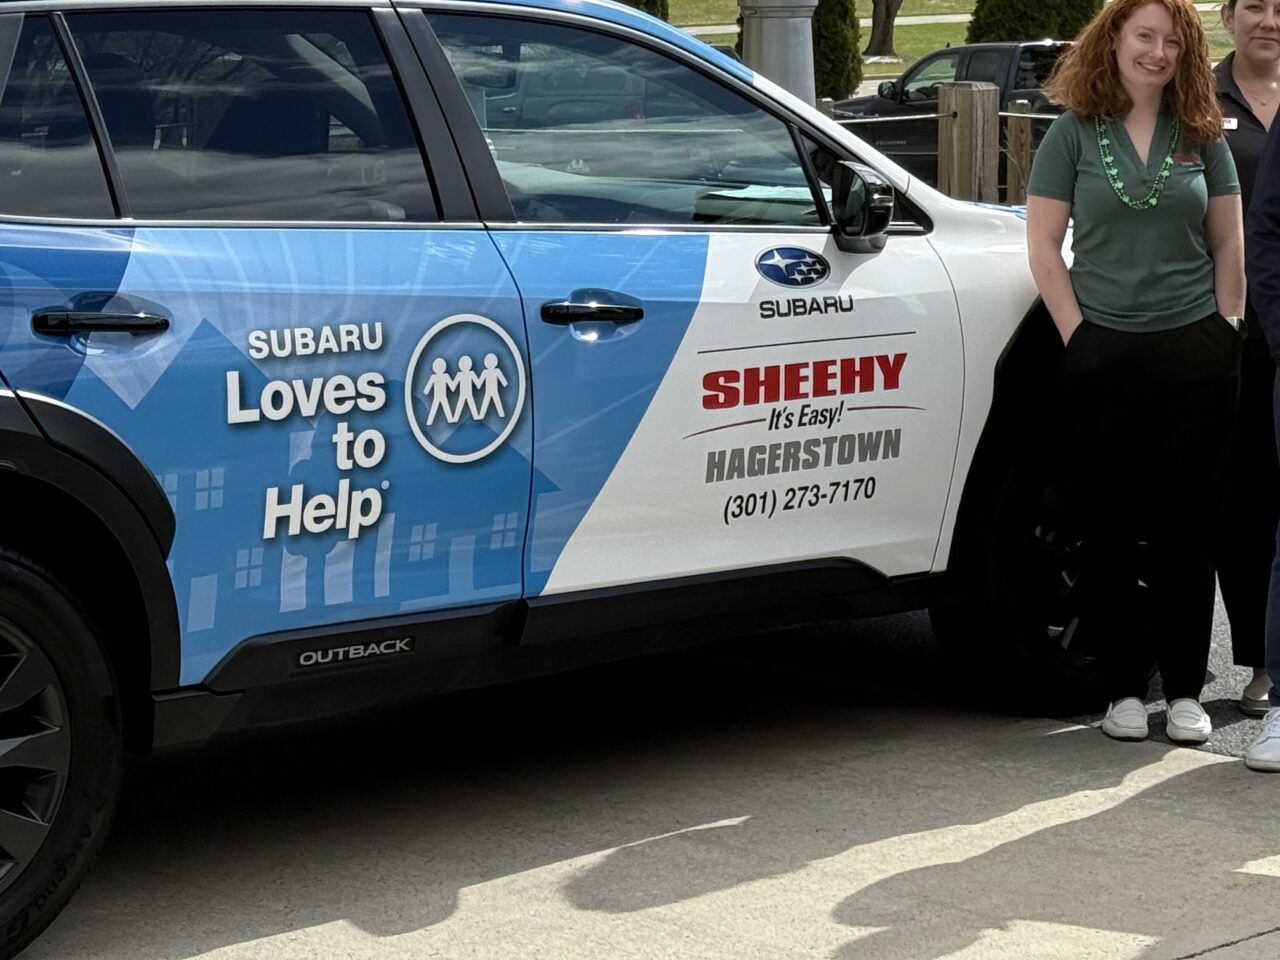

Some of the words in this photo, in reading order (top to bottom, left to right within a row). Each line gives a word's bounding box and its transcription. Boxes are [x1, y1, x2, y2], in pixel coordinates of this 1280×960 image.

[759, 295, 854, 319] SUBARU
[249, 322, 383, 359] SUBARU
[226, 370, 386, 424] Loves
[702, 352, 908, 410] SHEEHY
[768, 406, 794, 431] It's
[798, 401, 845, 429] Easy!
[332, 422, 386, 470] to
[705, 429, 902, 483] HAGERSTOWN
[263, 478, 383, 539] Help
[723, 490, 777, 525] (301)
[783, 476, 876, 511] 273-7170
[300, 638, 411, 665] OUTBACK
